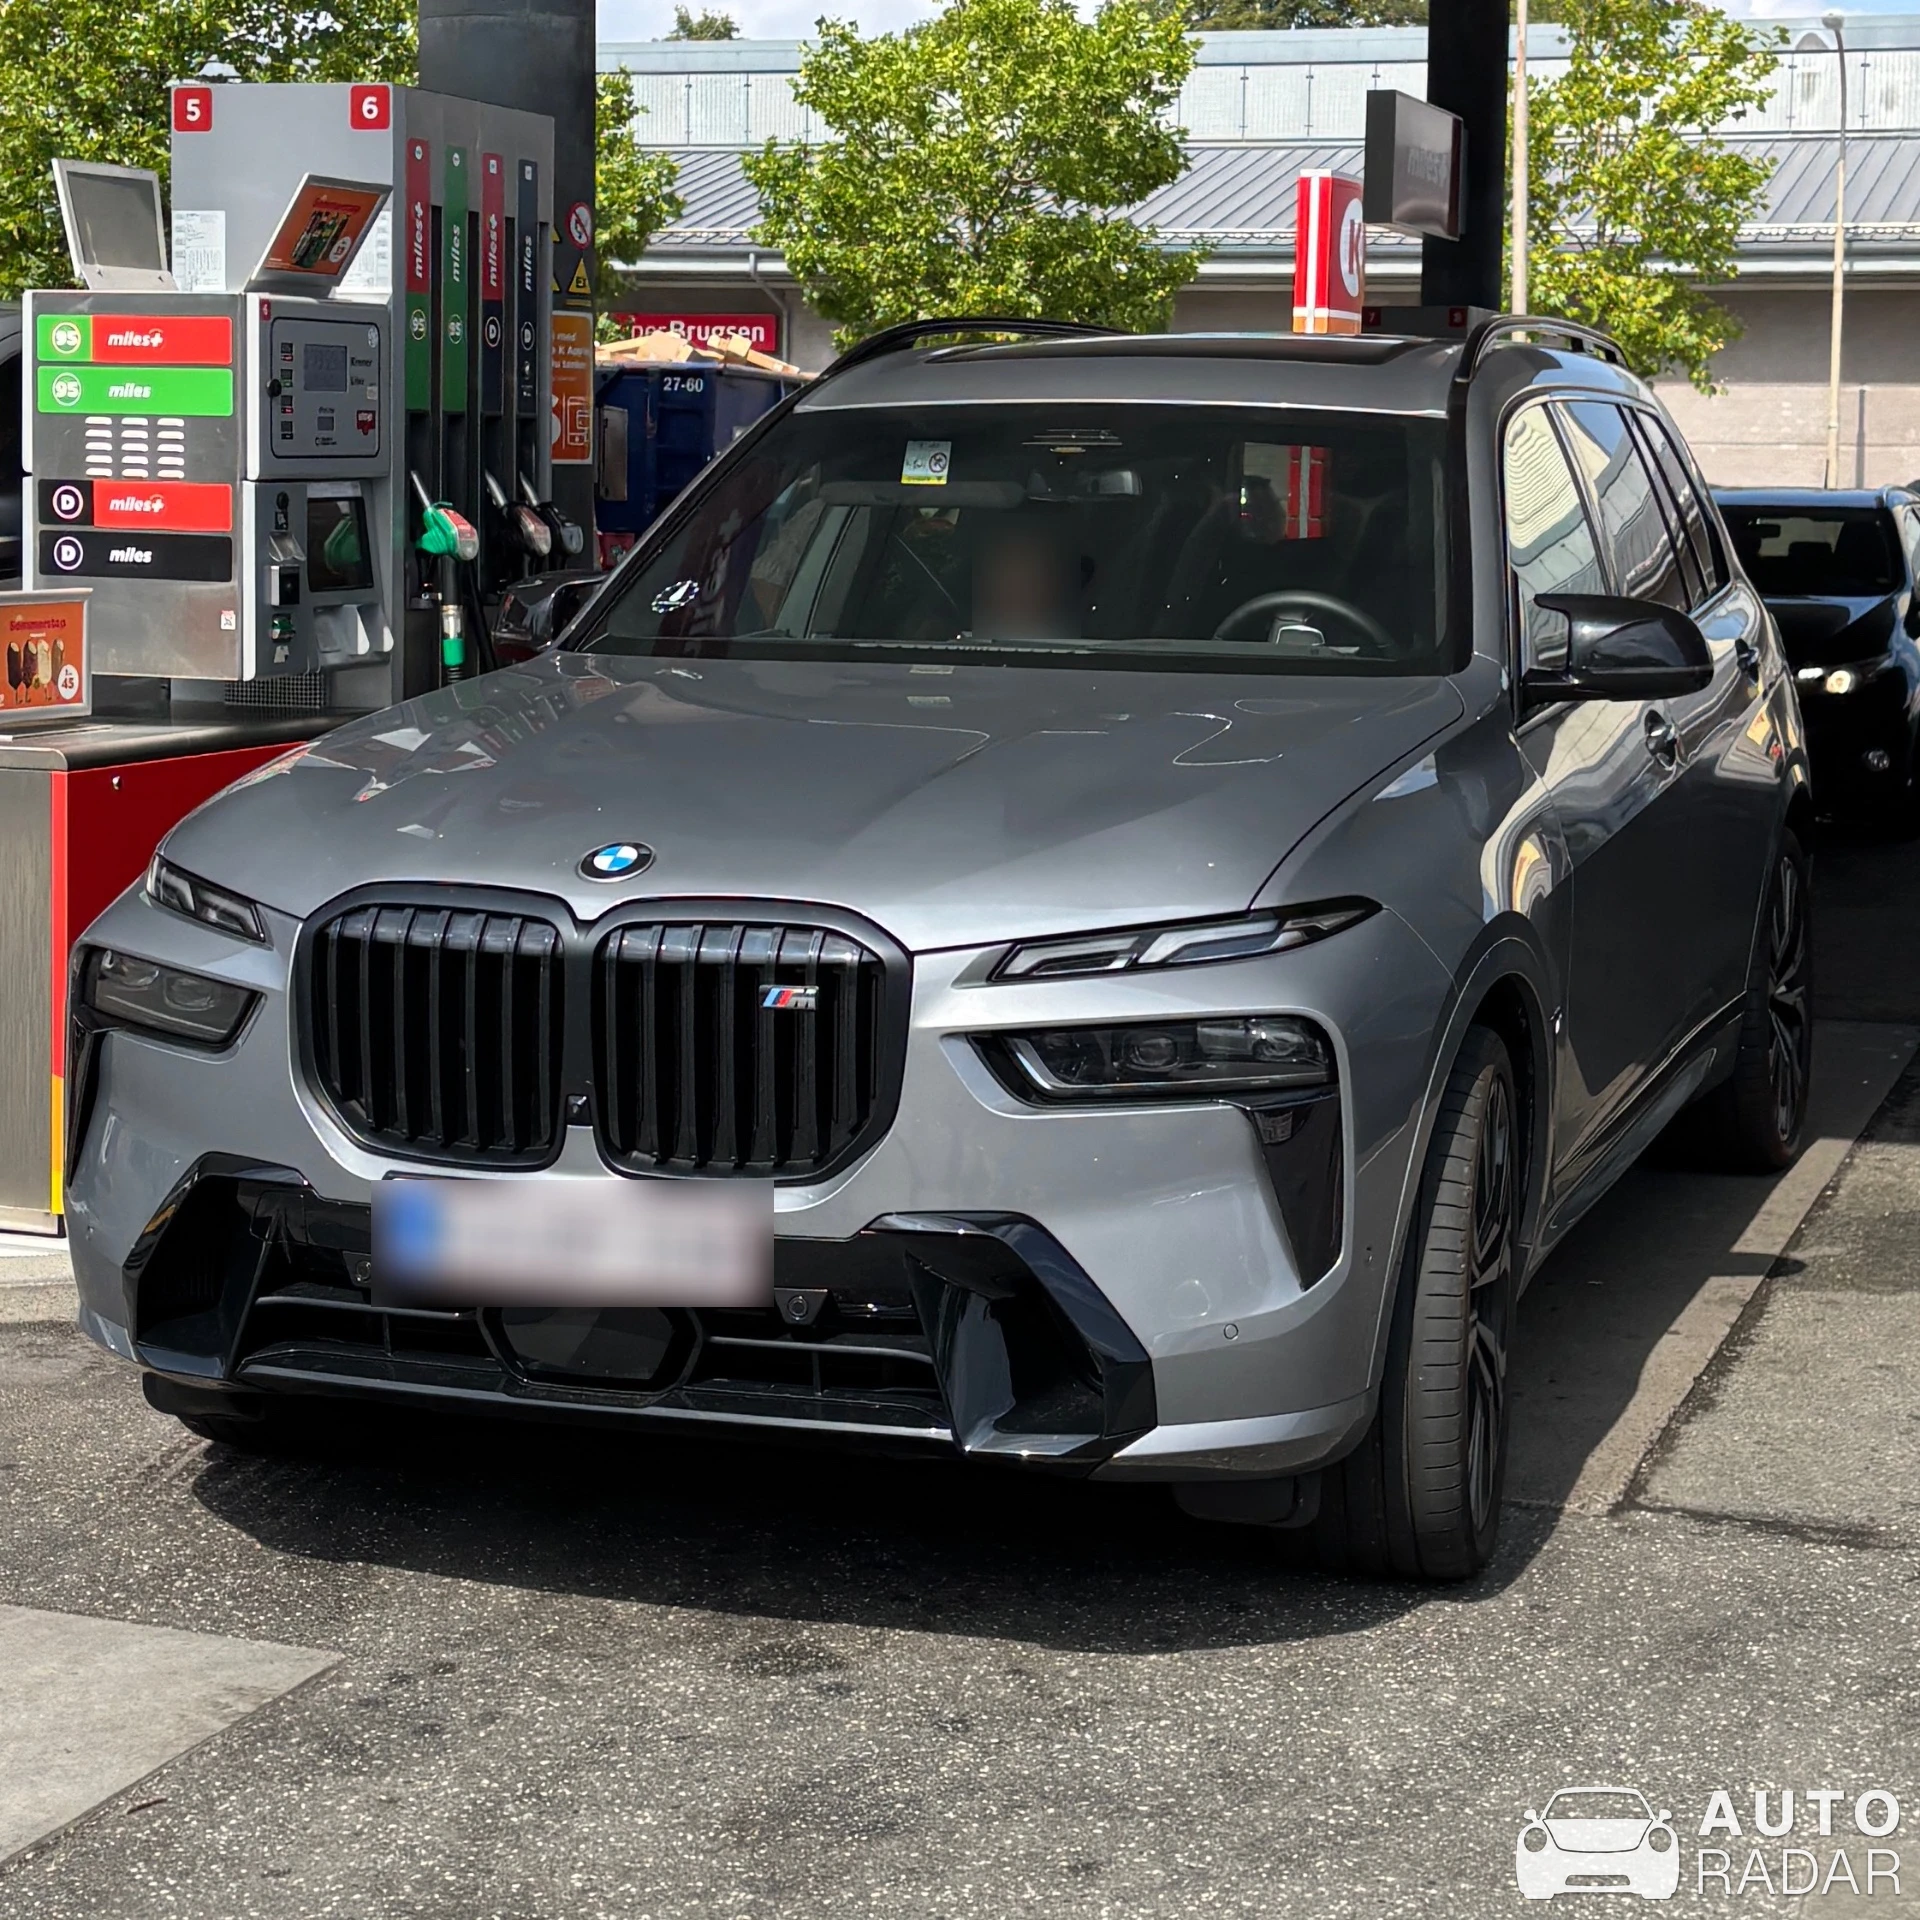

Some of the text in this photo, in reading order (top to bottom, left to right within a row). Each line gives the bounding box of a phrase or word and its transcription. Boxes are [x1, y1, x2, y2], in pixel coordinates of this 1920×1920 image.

[186, 98, 201, 122] 5
[361, 96, 379, 120] 6
[413, 201, 423, 279] miles+
[450, 224, 461, 283] miles
[488, 213, 498, 287] miles+
[523, 235, 532, 291] miles
[412, 317, 426, 332] 95
[488, 324, 498, 340] D
[54, 330, 164, 348] 95 miles+
[54, 380, 152, 399] 95 miles
[662, 376, 704, 392] 27-60
[60, 494, 165, 513] D miles+
[60, 544, 153, 563] D miles
[61, 677, 75, 690] 45
